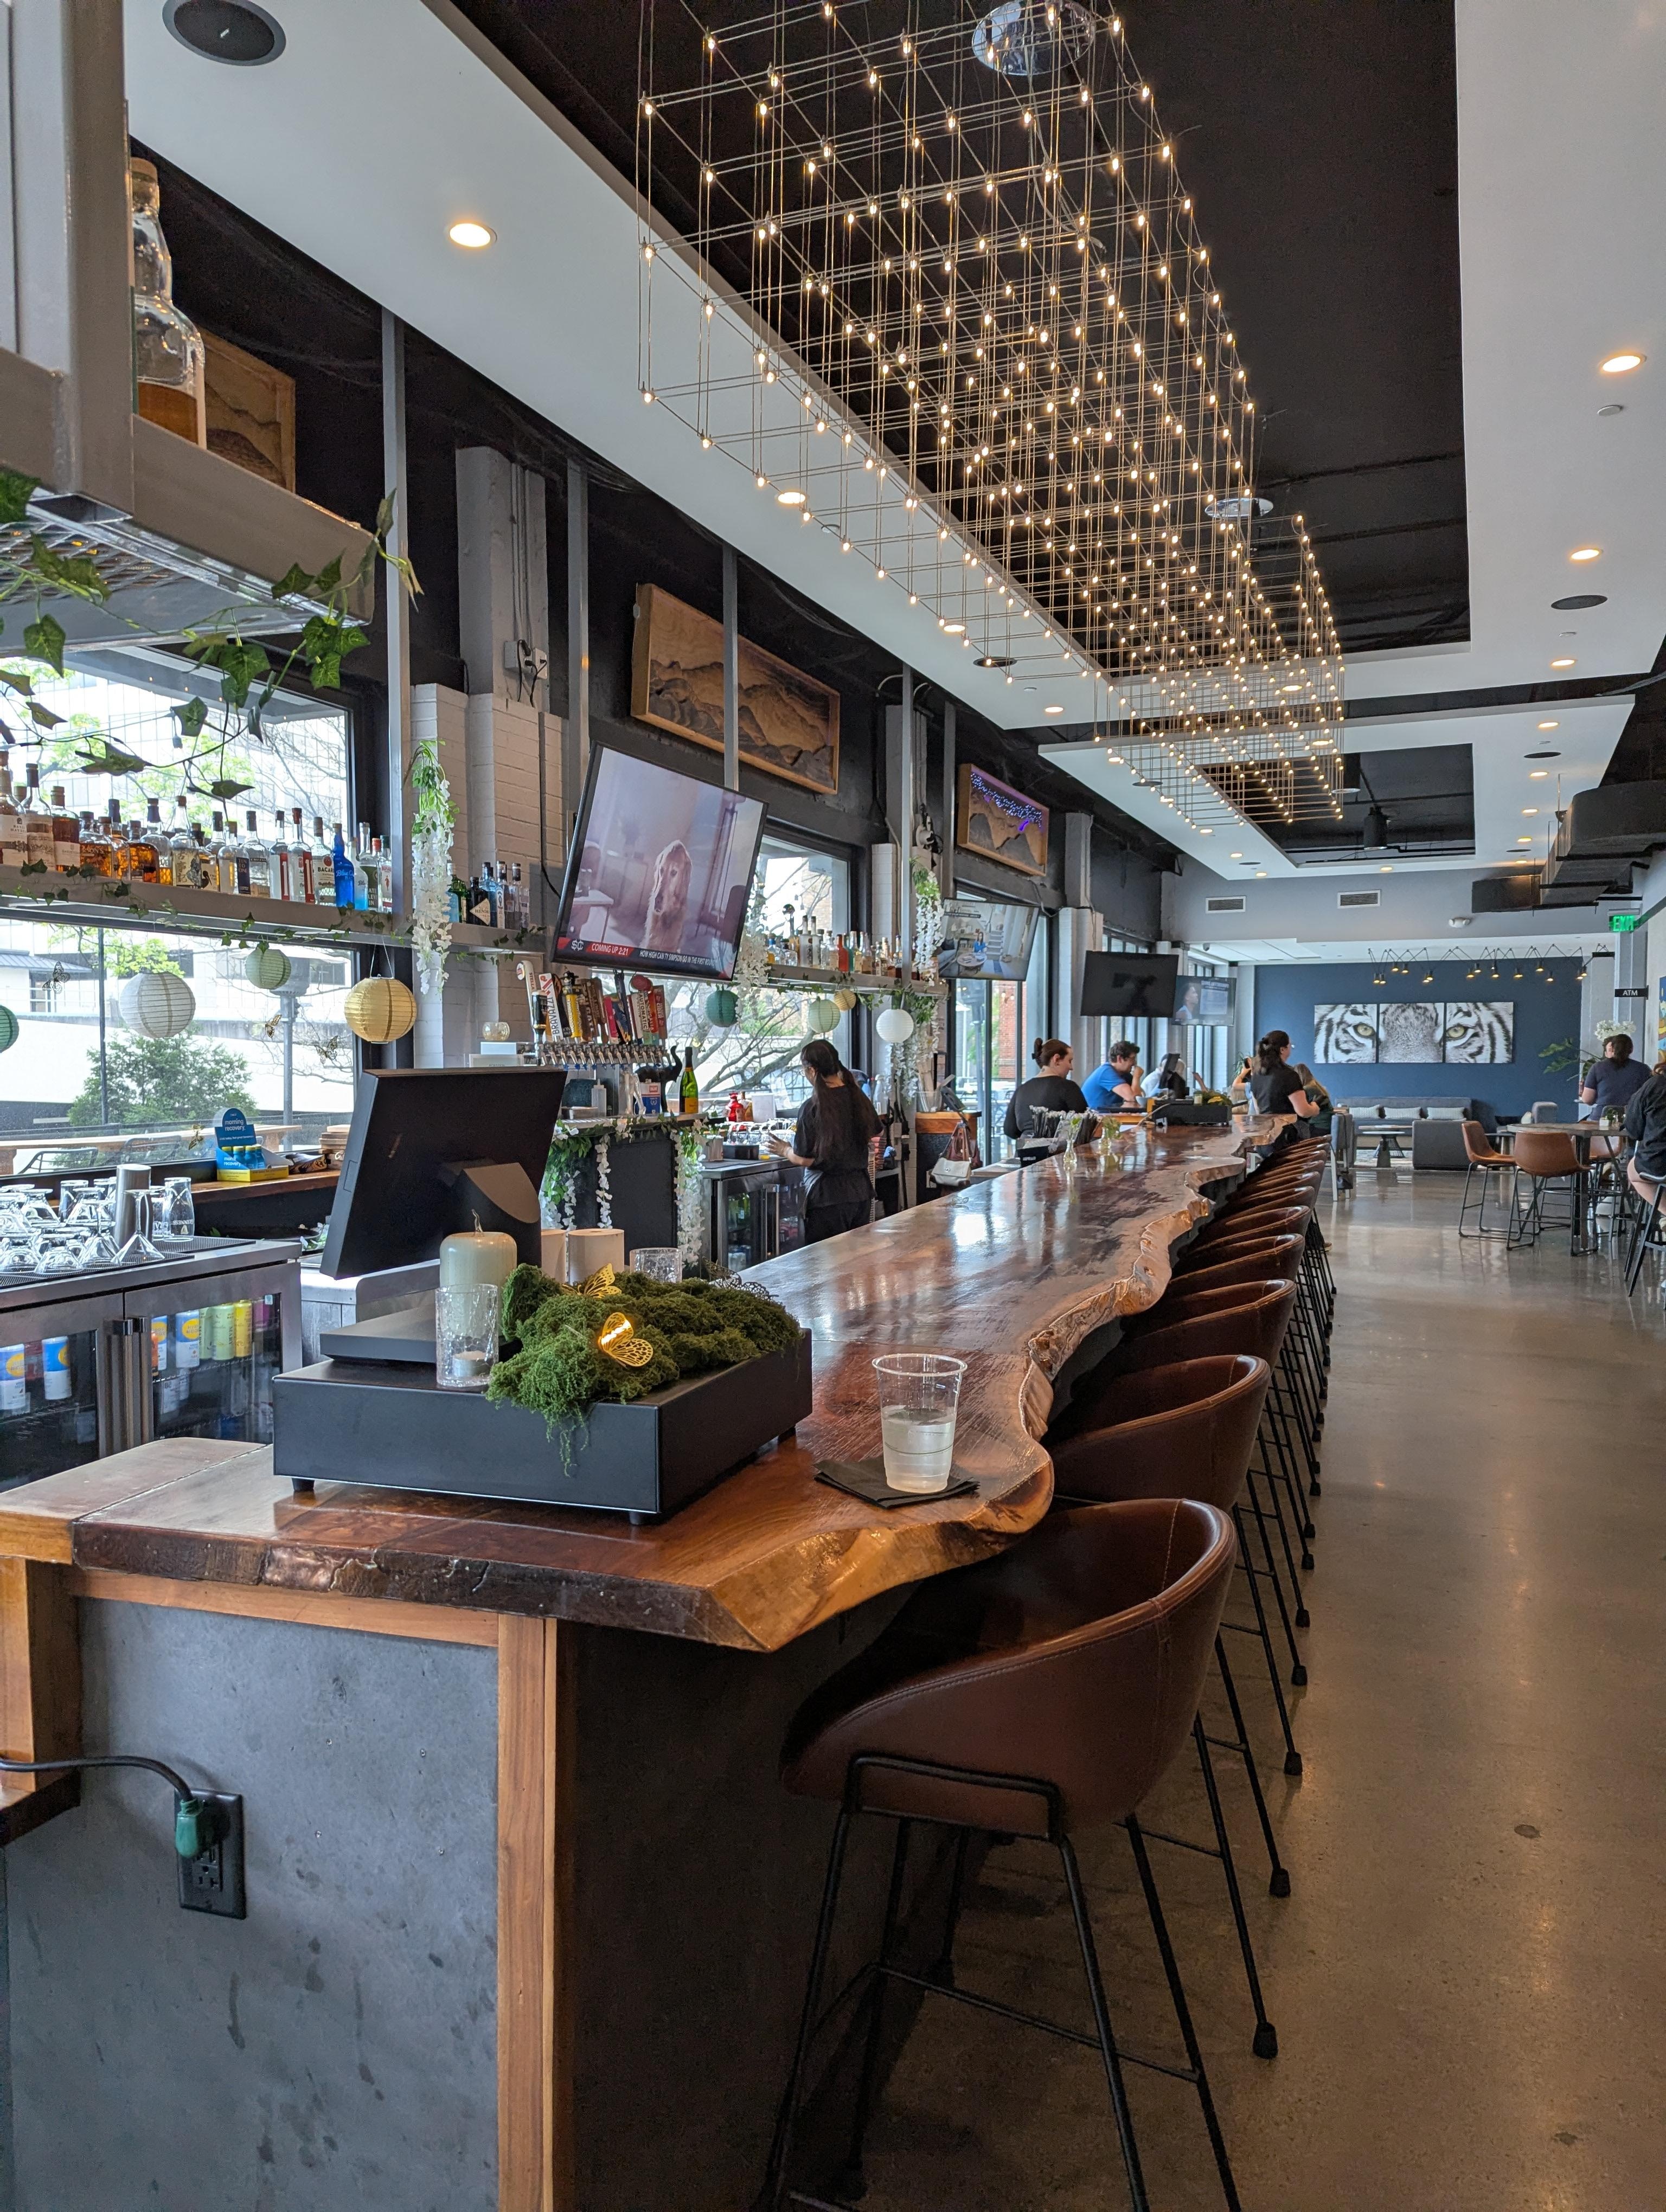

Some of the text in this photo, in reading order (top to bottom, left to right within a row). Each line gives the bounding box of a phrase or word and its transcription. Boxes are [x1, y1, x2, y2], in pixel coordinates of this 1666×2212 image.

[1613, 915, 1635, 931] EXIT
[591, 943, 611, 953] COMING
[619, 947, 629, 956] 2:21
[639, 950, 649, 958] HOW
[669, 954, 682, 962] SIMPSON
[547, 997, 560, 1035] BRAVAZZI
[638, 994, 648, 1030] AUTOMATIC
